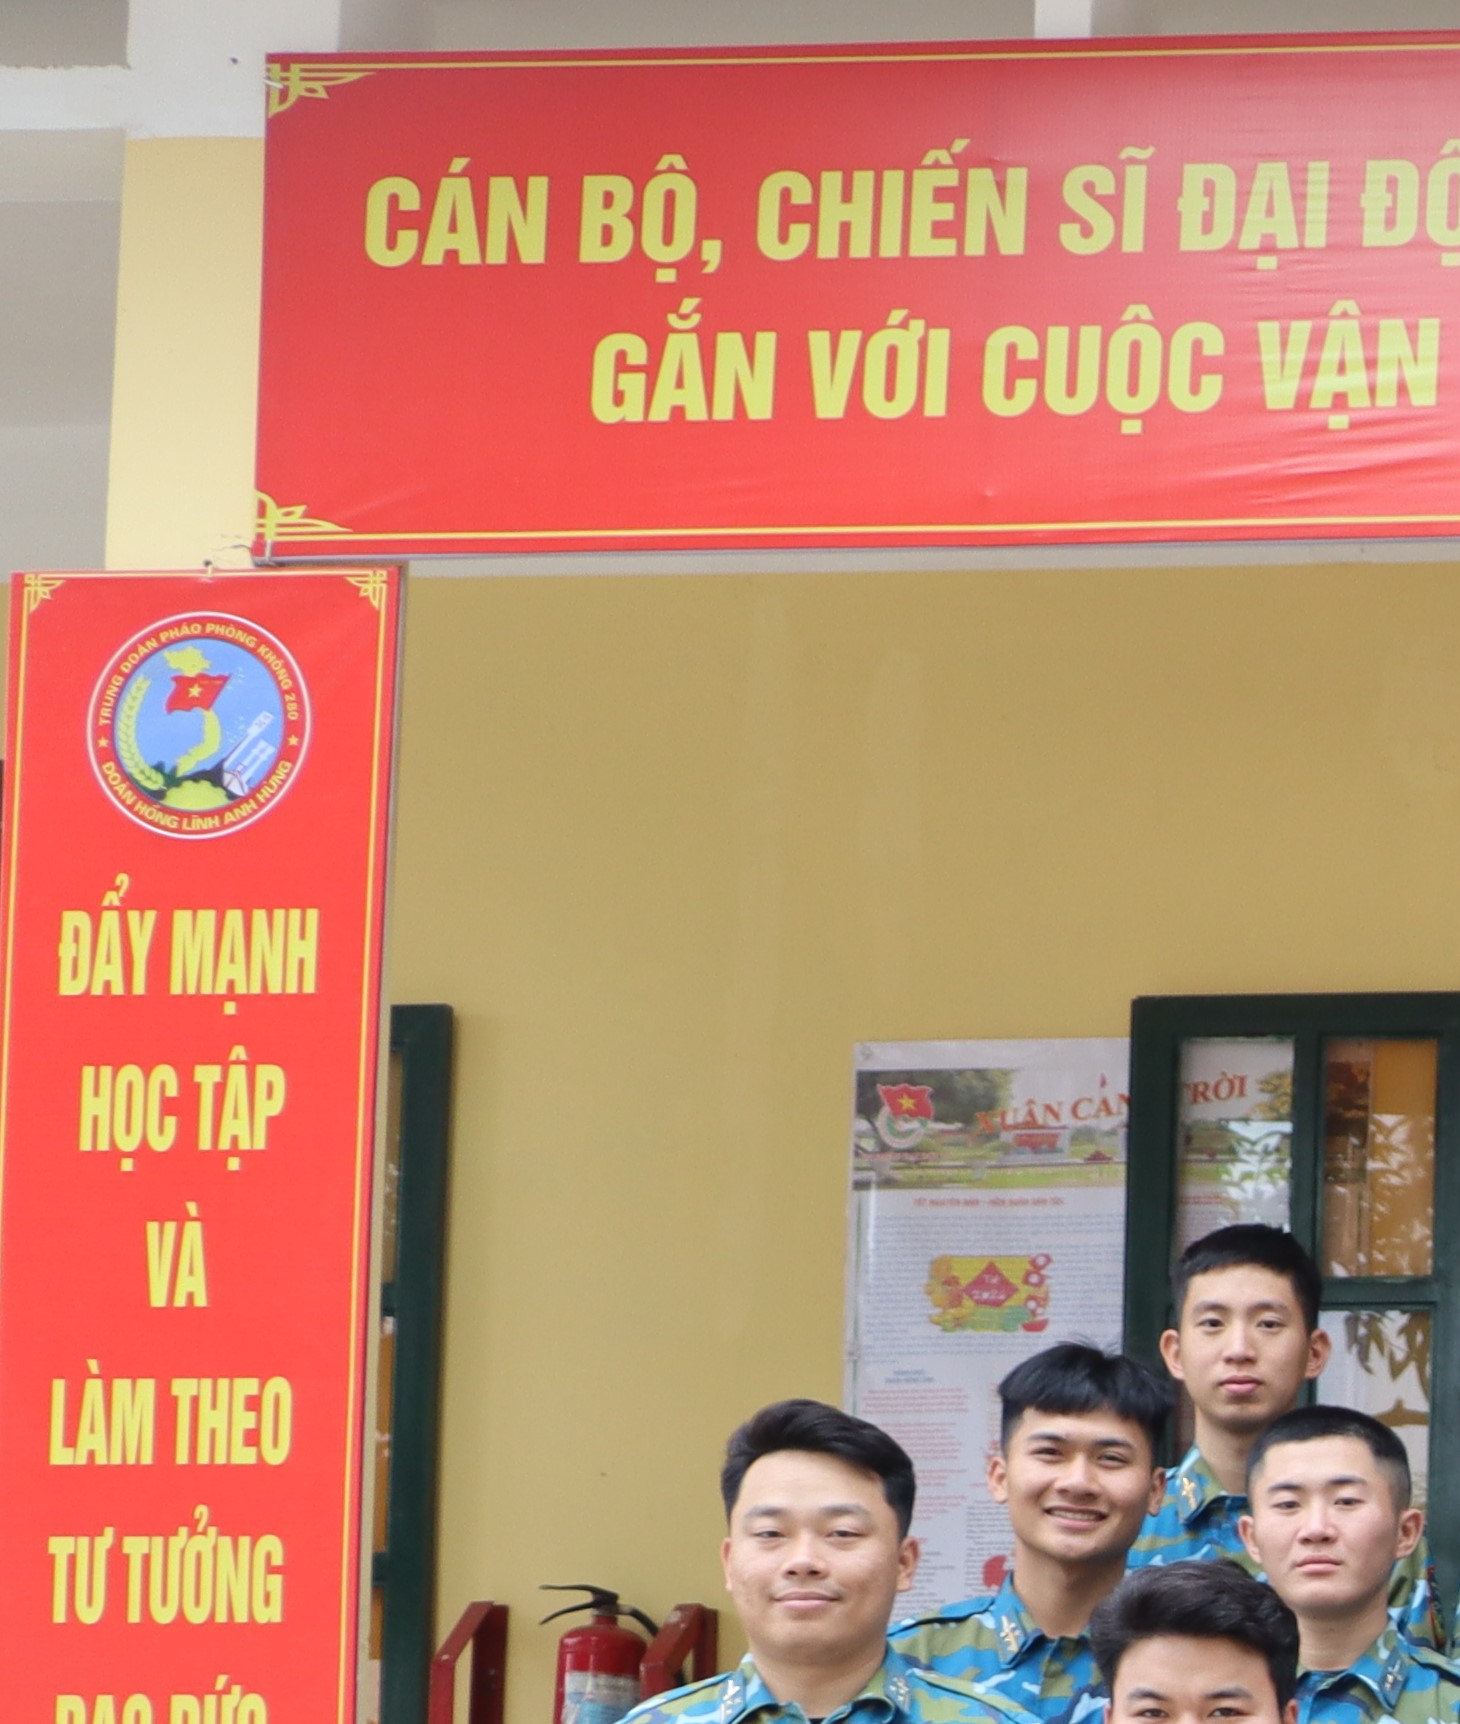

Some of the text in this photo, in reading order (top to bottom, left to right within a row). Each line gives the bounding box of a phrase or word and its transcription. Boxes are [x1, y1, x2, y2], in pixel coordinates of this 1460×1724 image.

[364, 156, 549, 267] CÁN
[578, 153, 722, 283] BỘ,
[756, 137, 1029, 261] CHIẾN
[1058, 146, 1154, 255] SĨ
[1176, 160, 1330, 271] ĐẠI
[590, 296, 778, 423] GẮN
[807, 308, 951, 419] VỚI
[981, 303, 1225, 434] CUỘC
[1257, 299, 1441, 430] VẬN
[99, 623, 299, 725] TRUNG PHÁO PHÒNG 280
[224, 802, 258, 825] ANH
[57, 872, 319, 1015] ĐẨY MẠNH
[78, 1045, 286, 1172] HỌC TẬP
[145, 1201, 208, 1308] VÀ
[48, 1358, 293, 1466] LÀM THEO
[47, 1504, 285, 1625] TƯ TƯỞNG
